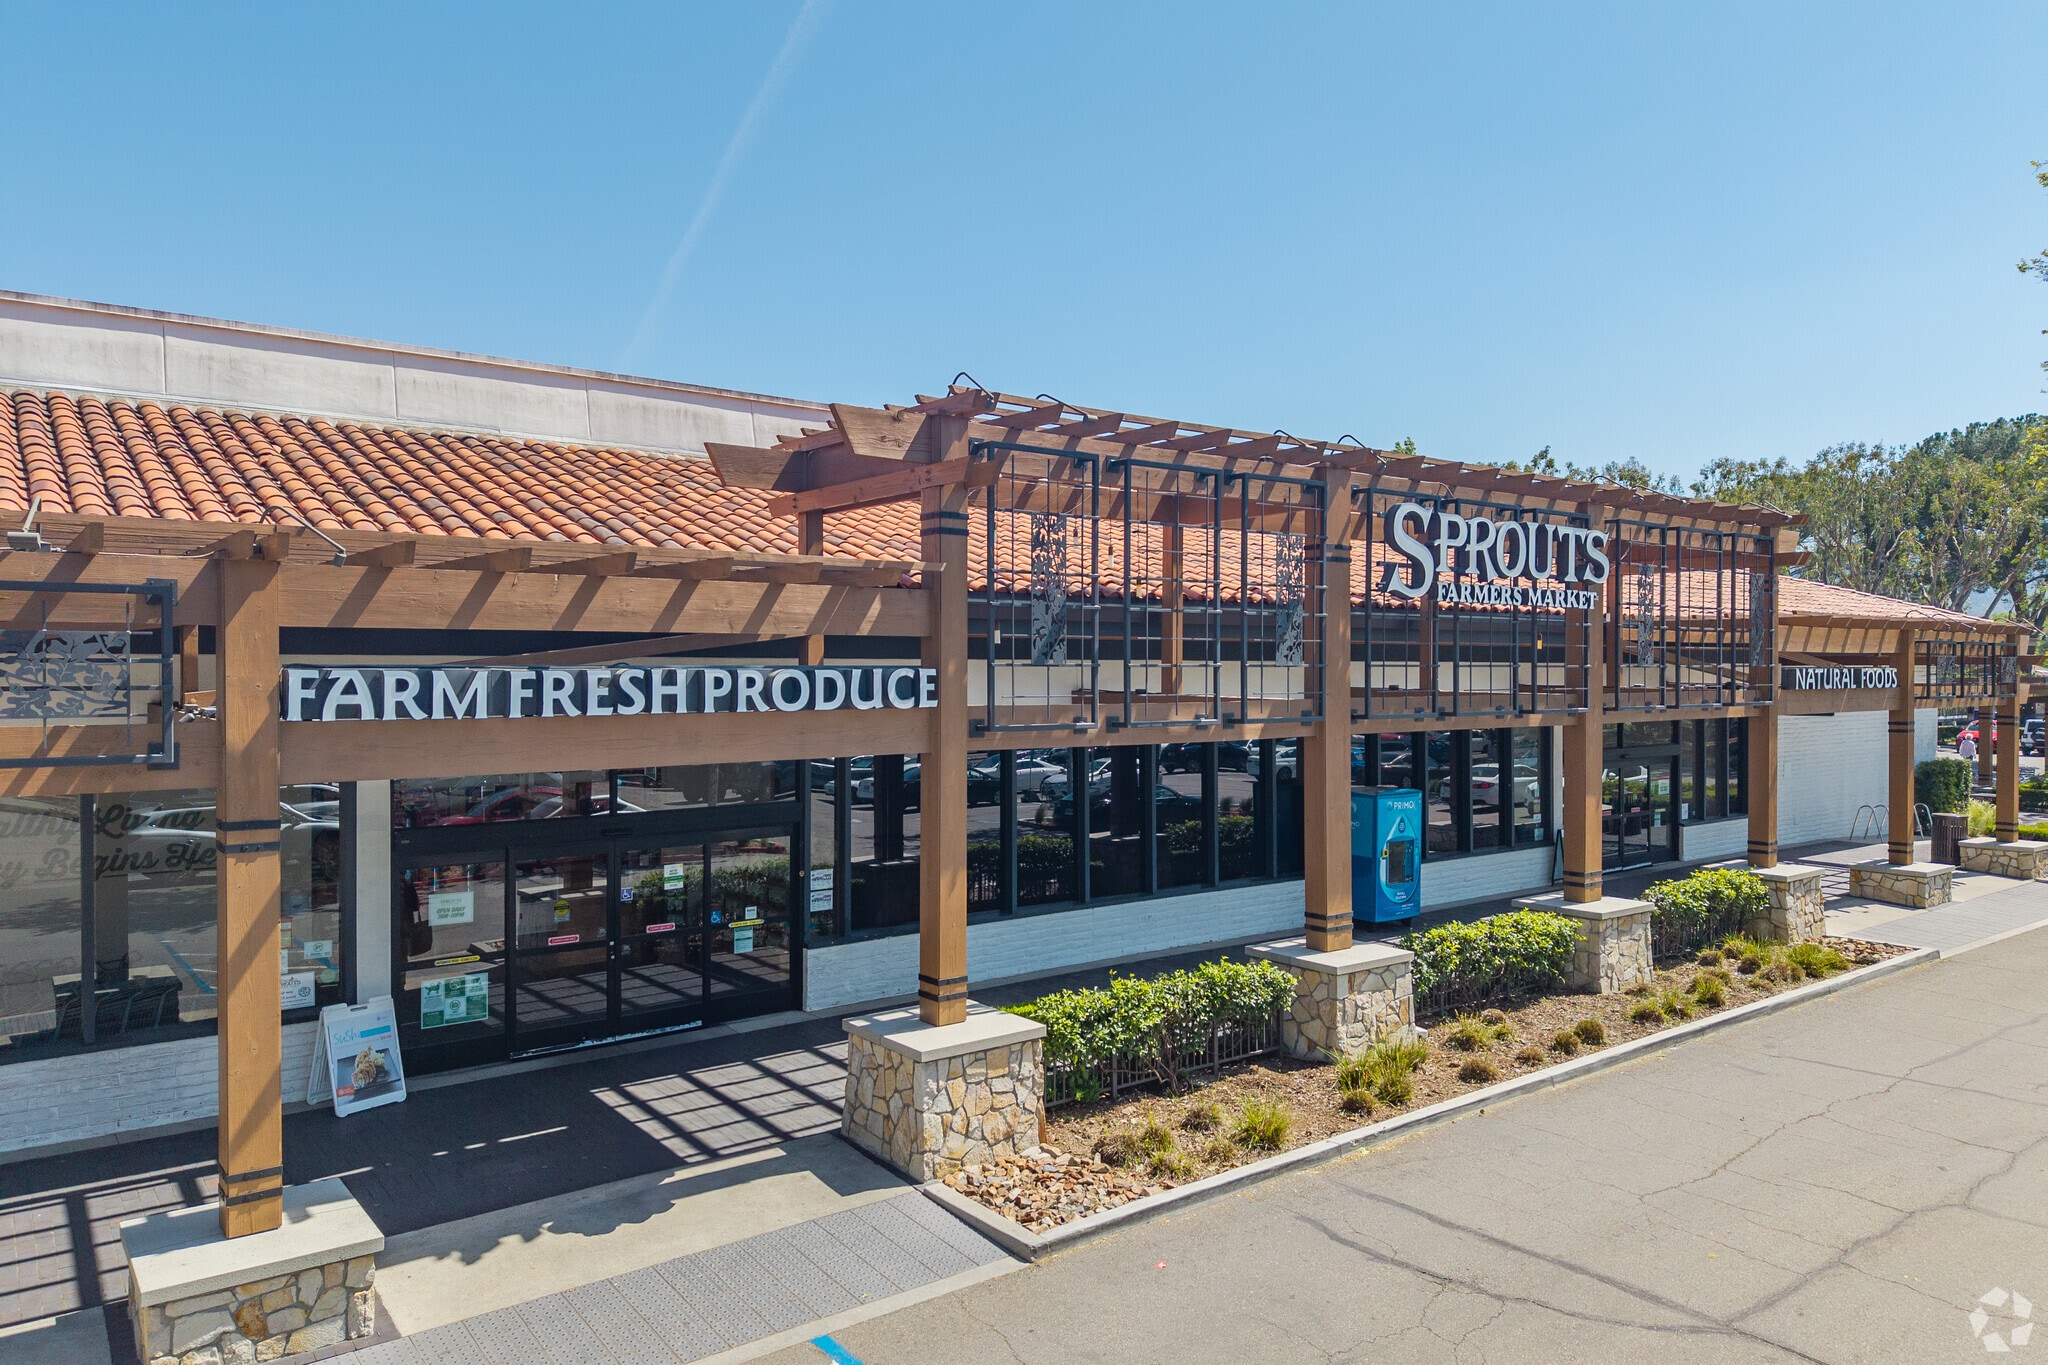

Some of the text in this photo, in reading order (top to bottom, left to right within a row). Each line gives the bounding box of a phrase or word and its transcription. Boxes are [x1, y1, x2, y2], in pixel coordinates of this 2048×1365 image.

[1386, 502, 1610, 598] SPROUTS
[1437, 581, 1596, 610] FARMERS MARKET
[286, 667, 939, 722] FARM FRESH PRODUCE
[1795, 667, 1898, 690] NATURAL FOODS
